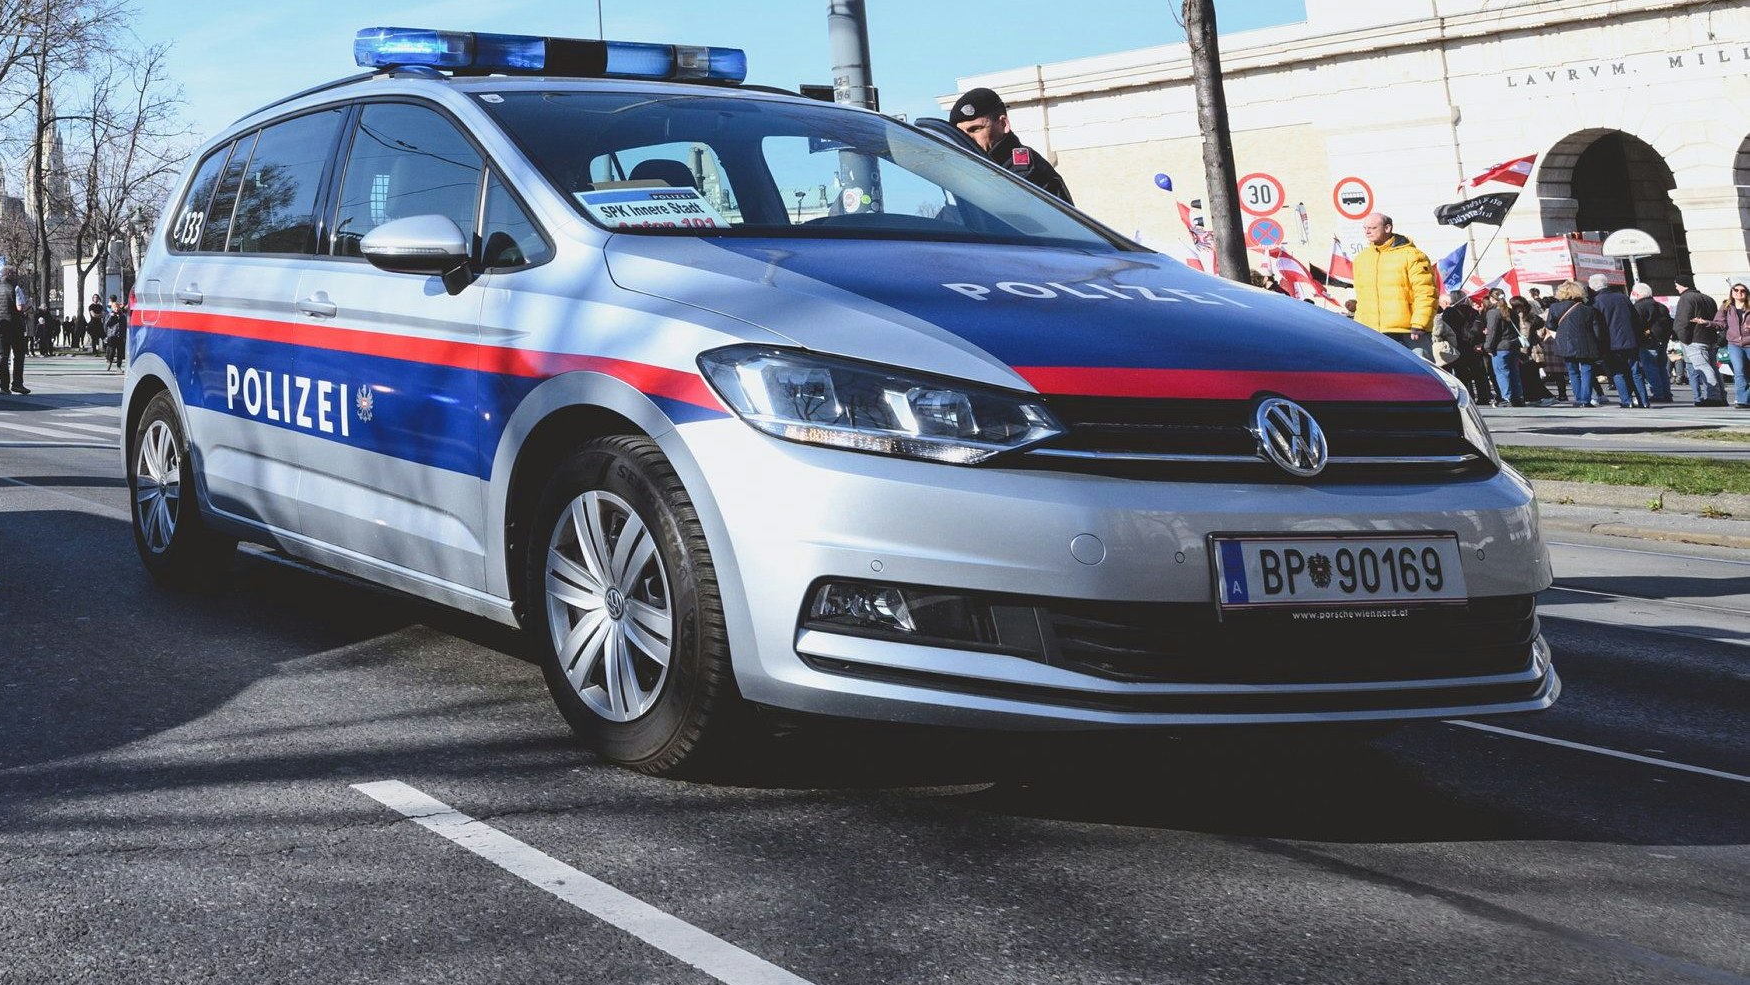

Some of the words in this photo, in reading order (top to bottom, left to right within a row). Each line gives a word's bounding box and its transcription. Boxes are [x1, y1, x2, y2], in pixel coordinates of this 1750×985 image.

[600, 204, 631, 219] SPK
[627, 204, 668, 217] Innere
[668, 201, 705, 215] Stadt
[1248, 184, 1271, 205] 30
[181, 211, 204, 245] 133
[942, 281, 1254, 309] POLIZEI
[226, 364, 349, 437] POLIZEI
[1232, 580, 1243, 594] A
[1259, 549, 1305, 595] BP
[1335, 547, 1443, 594] 90169
